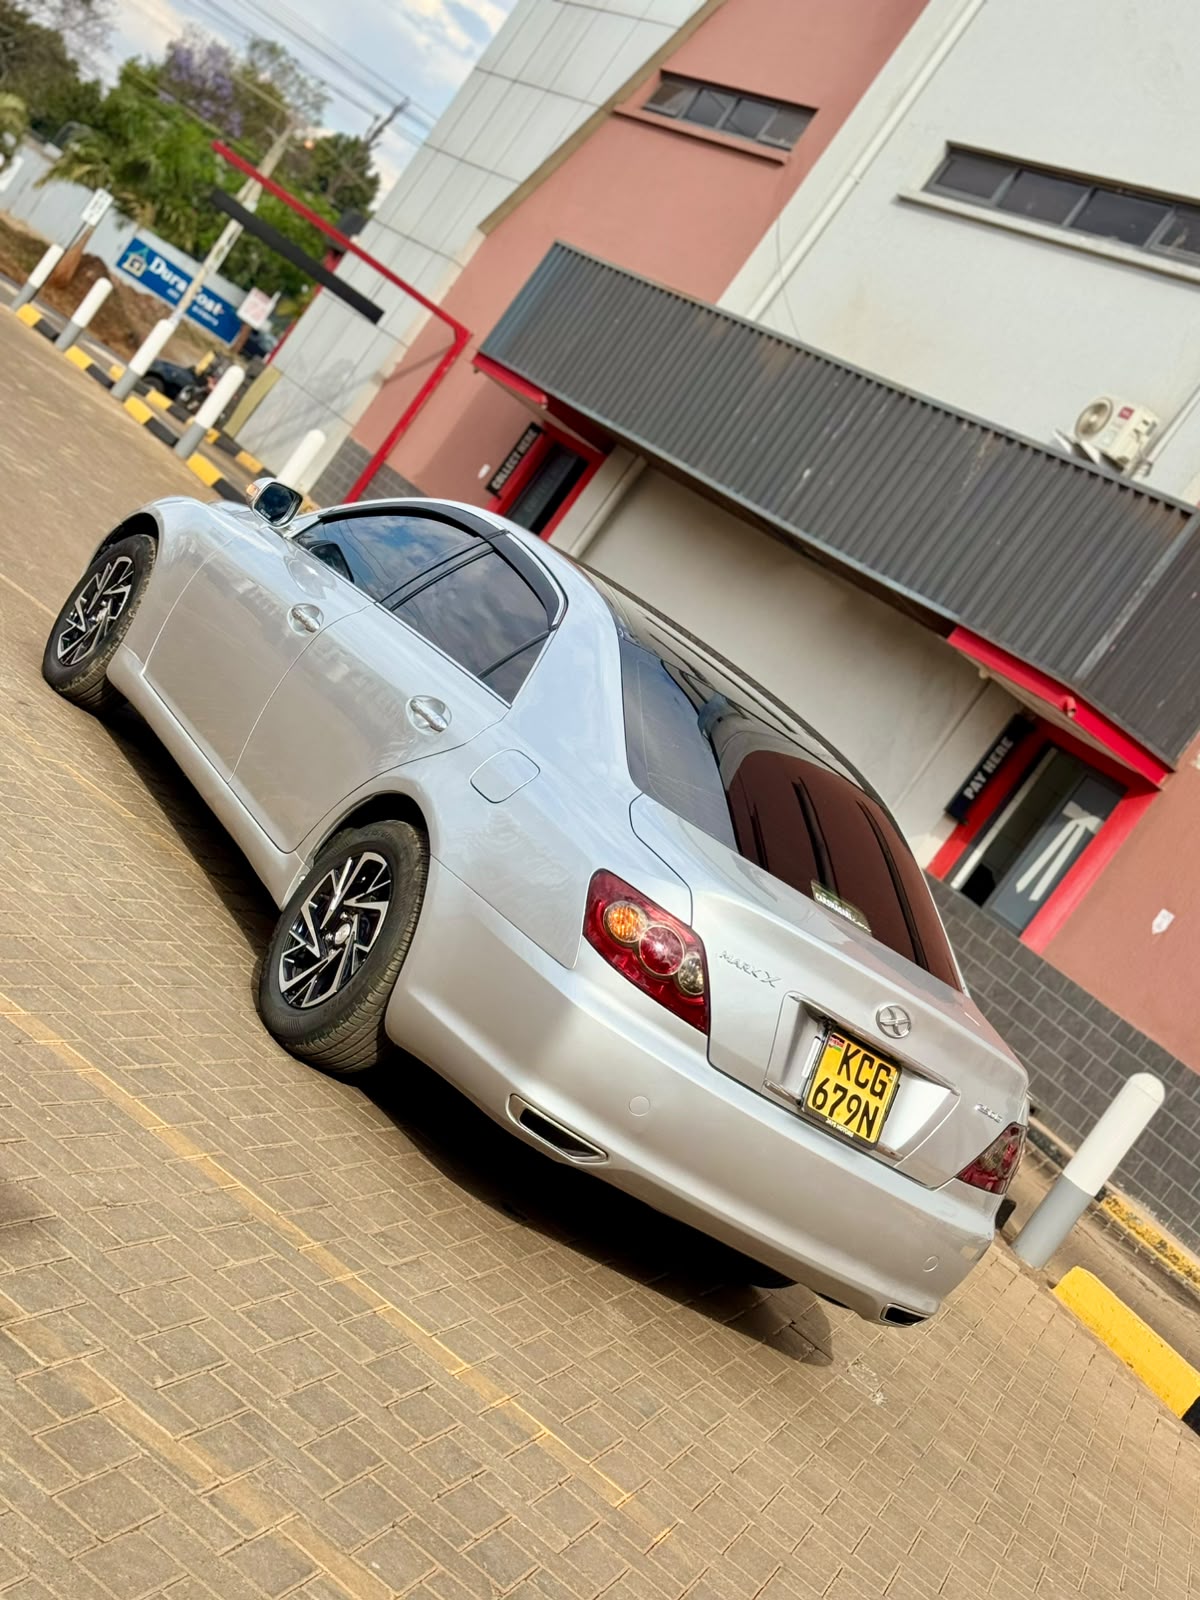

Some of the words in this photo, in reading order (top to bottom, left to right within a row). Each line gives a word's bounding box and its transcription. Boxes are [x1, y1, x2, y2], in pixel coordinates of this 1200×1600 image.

[149, 255, 224, 316] Duraoat
[491, 450, 521, 490] COLLECT
[963, 771, 987, 800] PAY
[982, 736, 1014, 774] HERE
[718, 950, 762, 979] MARK
[761, 971, 782, 988] X
[837, 1043, 892, 1101] KCG
[812, 1077, 880, 1139] 679N
